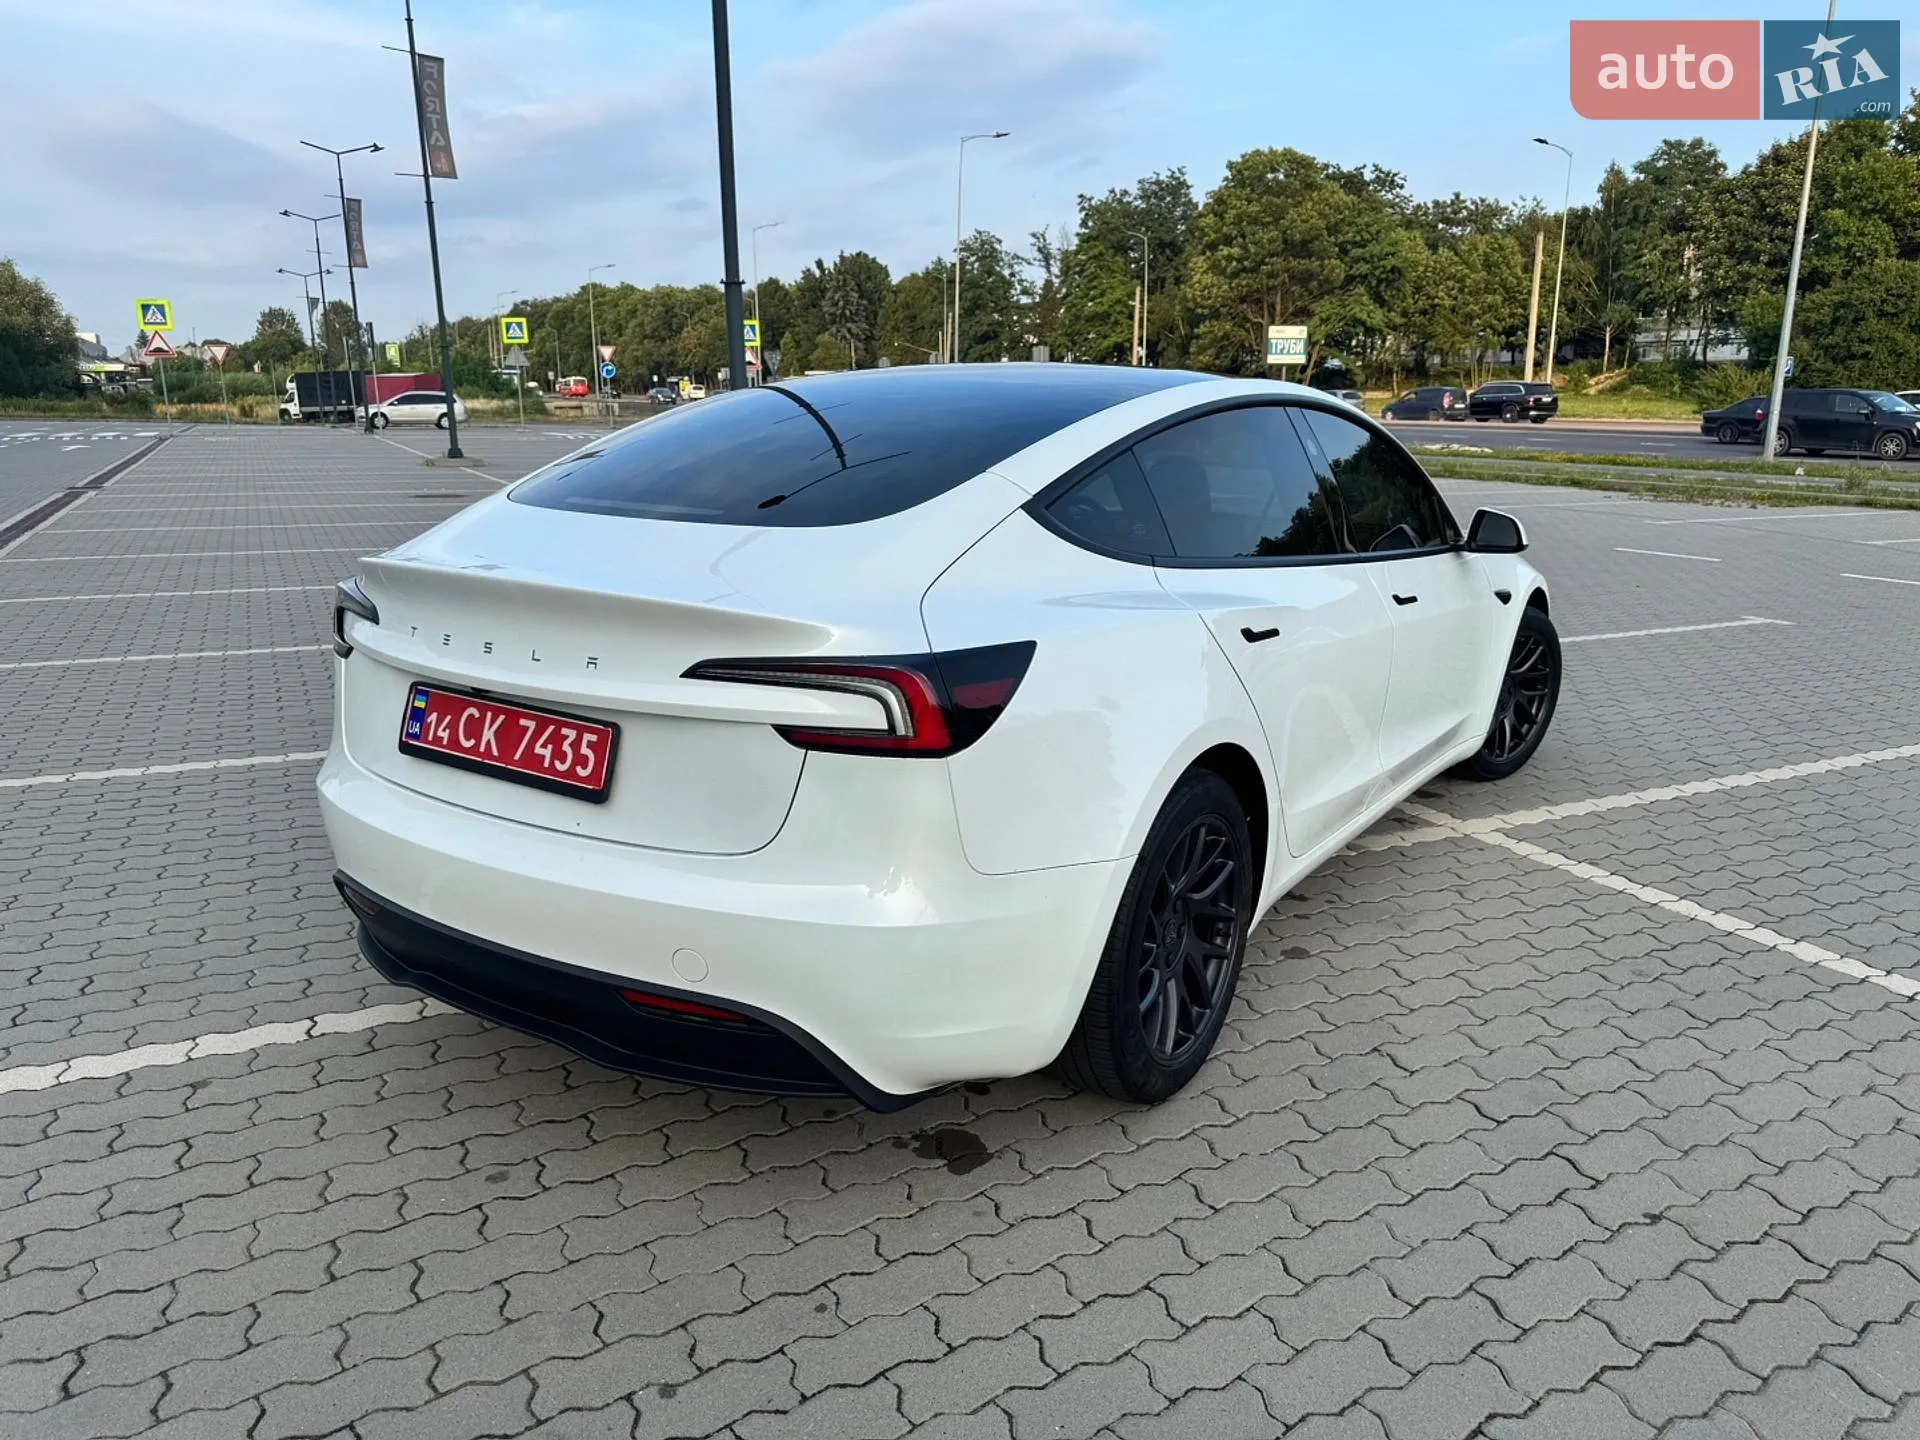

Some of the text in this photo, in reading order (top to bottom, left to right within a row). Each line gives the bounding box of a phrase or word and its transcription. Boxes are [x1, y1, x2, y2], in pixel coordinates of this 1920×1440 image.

[1270, 339, 1304, 354] ТРУБИ
[410, 626, 598, 670] TESLA
[408, 719, 421, 736] UA
[513, 718, 598, 778] 7435
